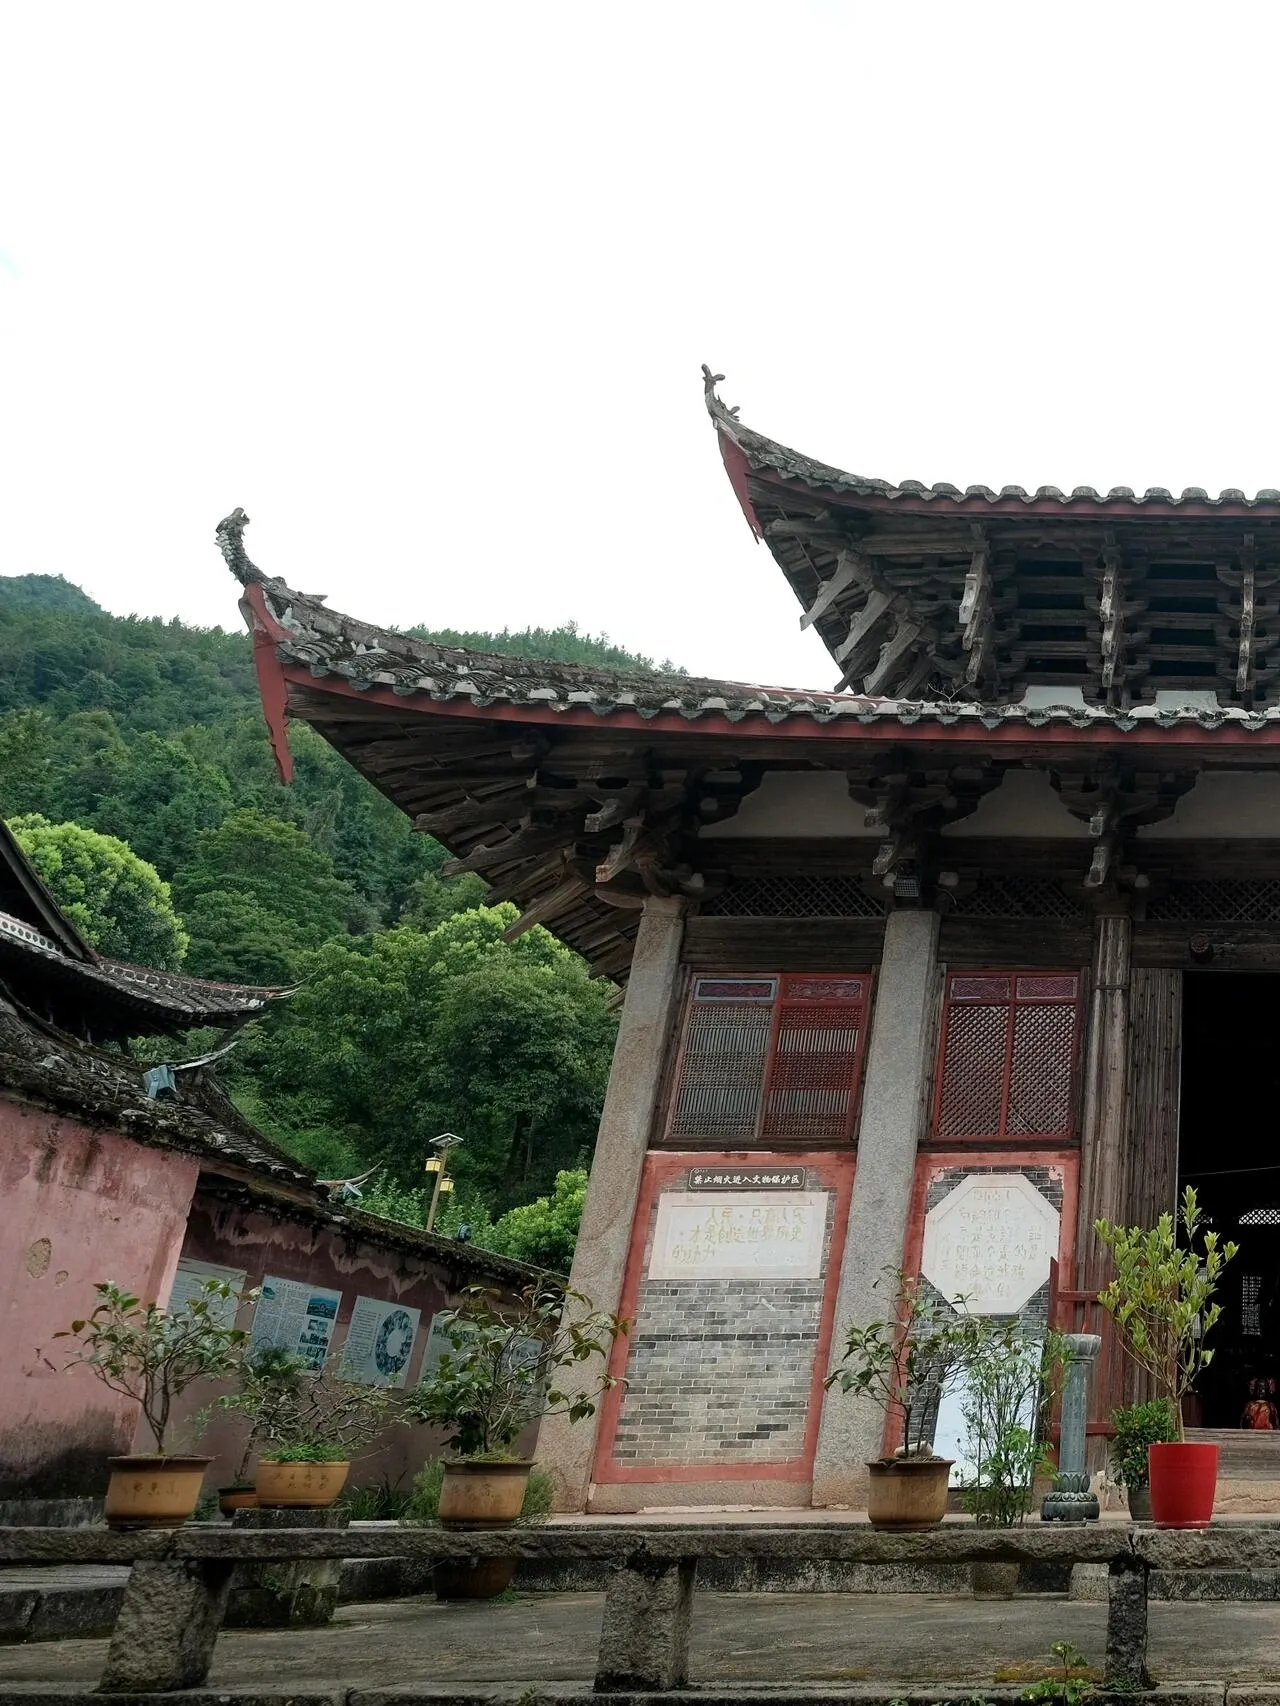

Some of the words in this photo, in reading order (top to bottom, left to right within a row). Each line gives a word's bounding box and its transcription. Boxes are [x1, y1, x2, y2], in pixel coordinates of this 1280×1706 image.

[693, 1174, 800, 1185] 禁止烟火进入文物保护区
